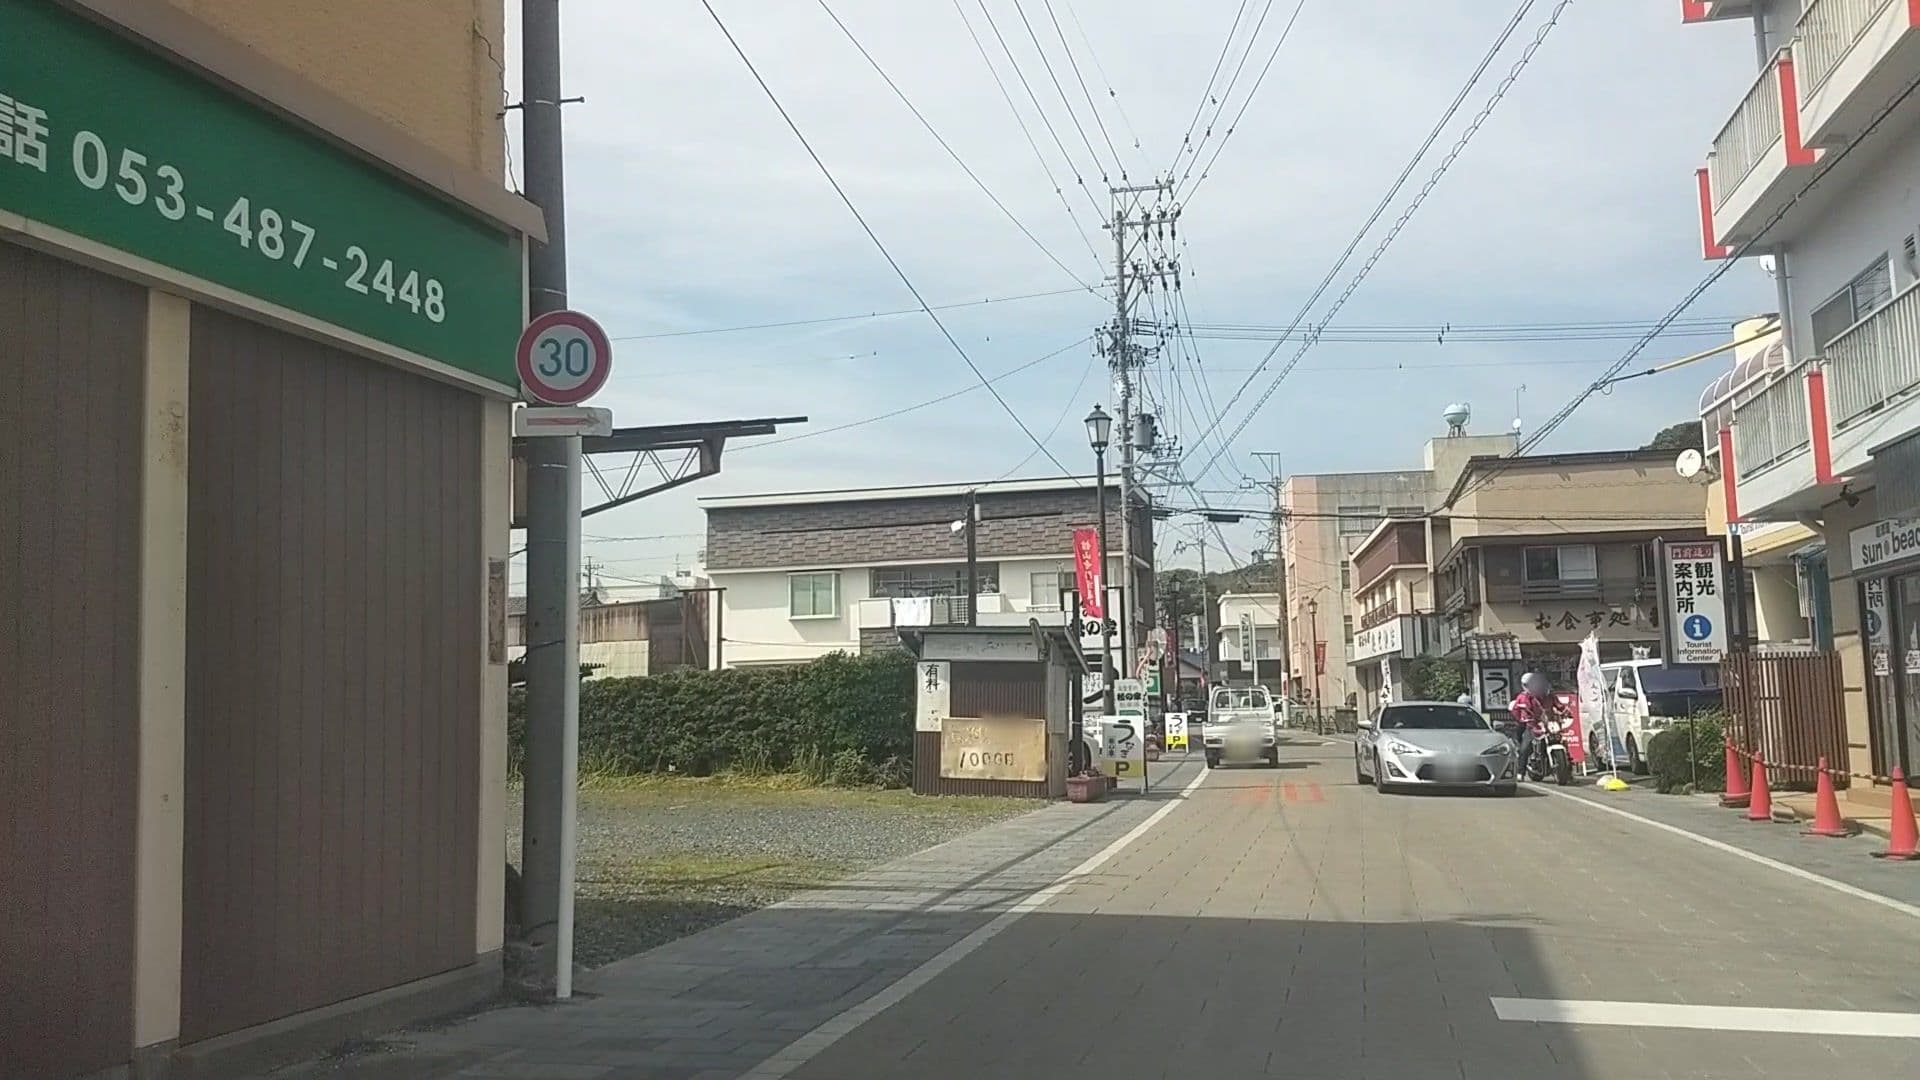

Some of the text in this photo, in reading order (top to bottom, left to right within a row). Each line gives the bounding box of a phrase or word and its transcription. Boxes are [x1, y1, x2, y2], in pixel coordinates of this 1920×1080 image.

[0, 93, 446, 324] 話 053-487-2448
[538, 337, 589, 378] 30
[1862, 542, 1883, 565] sun
[1674, 562, 1695, 614] 案内所
[1694, 561, 1716, 596] 観光
[1535, 610, 1631, 631] お食事処
[1677, 647, 1721, 655] Information
[1686, 654, 1713, 662] Center
[925, 663, 941, 694] 有料
[1172, 735, 1182, 745] P
[1114, 761, 1131, 776] P
